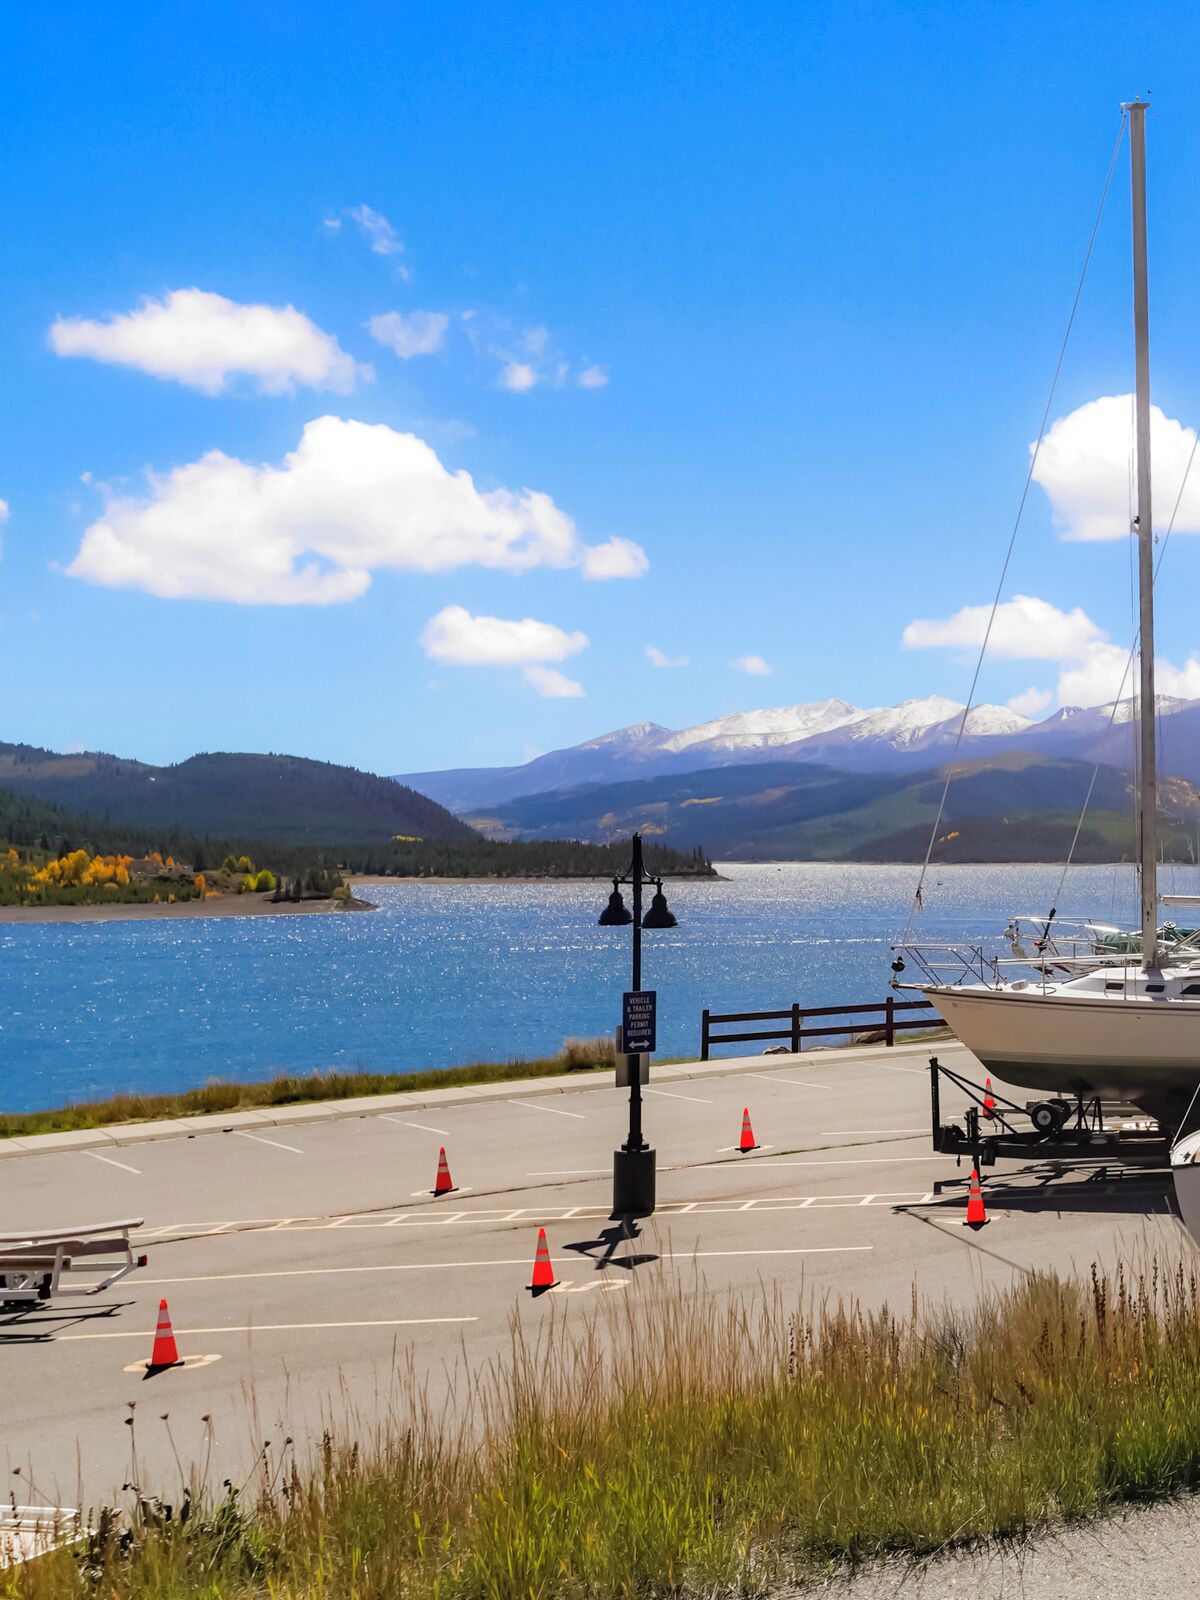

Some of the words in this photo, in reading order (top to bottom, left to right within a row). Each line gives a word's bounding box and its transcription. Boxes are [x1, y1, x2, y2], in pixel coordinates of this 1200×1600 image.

[629, 996, 650, 1005] VEHICLE
[632, 1004, 653, 1013] TRAILER
[629, 1012, 650, 1020] PARKING
[627, 1028, 652, 1037] REQUIRED
